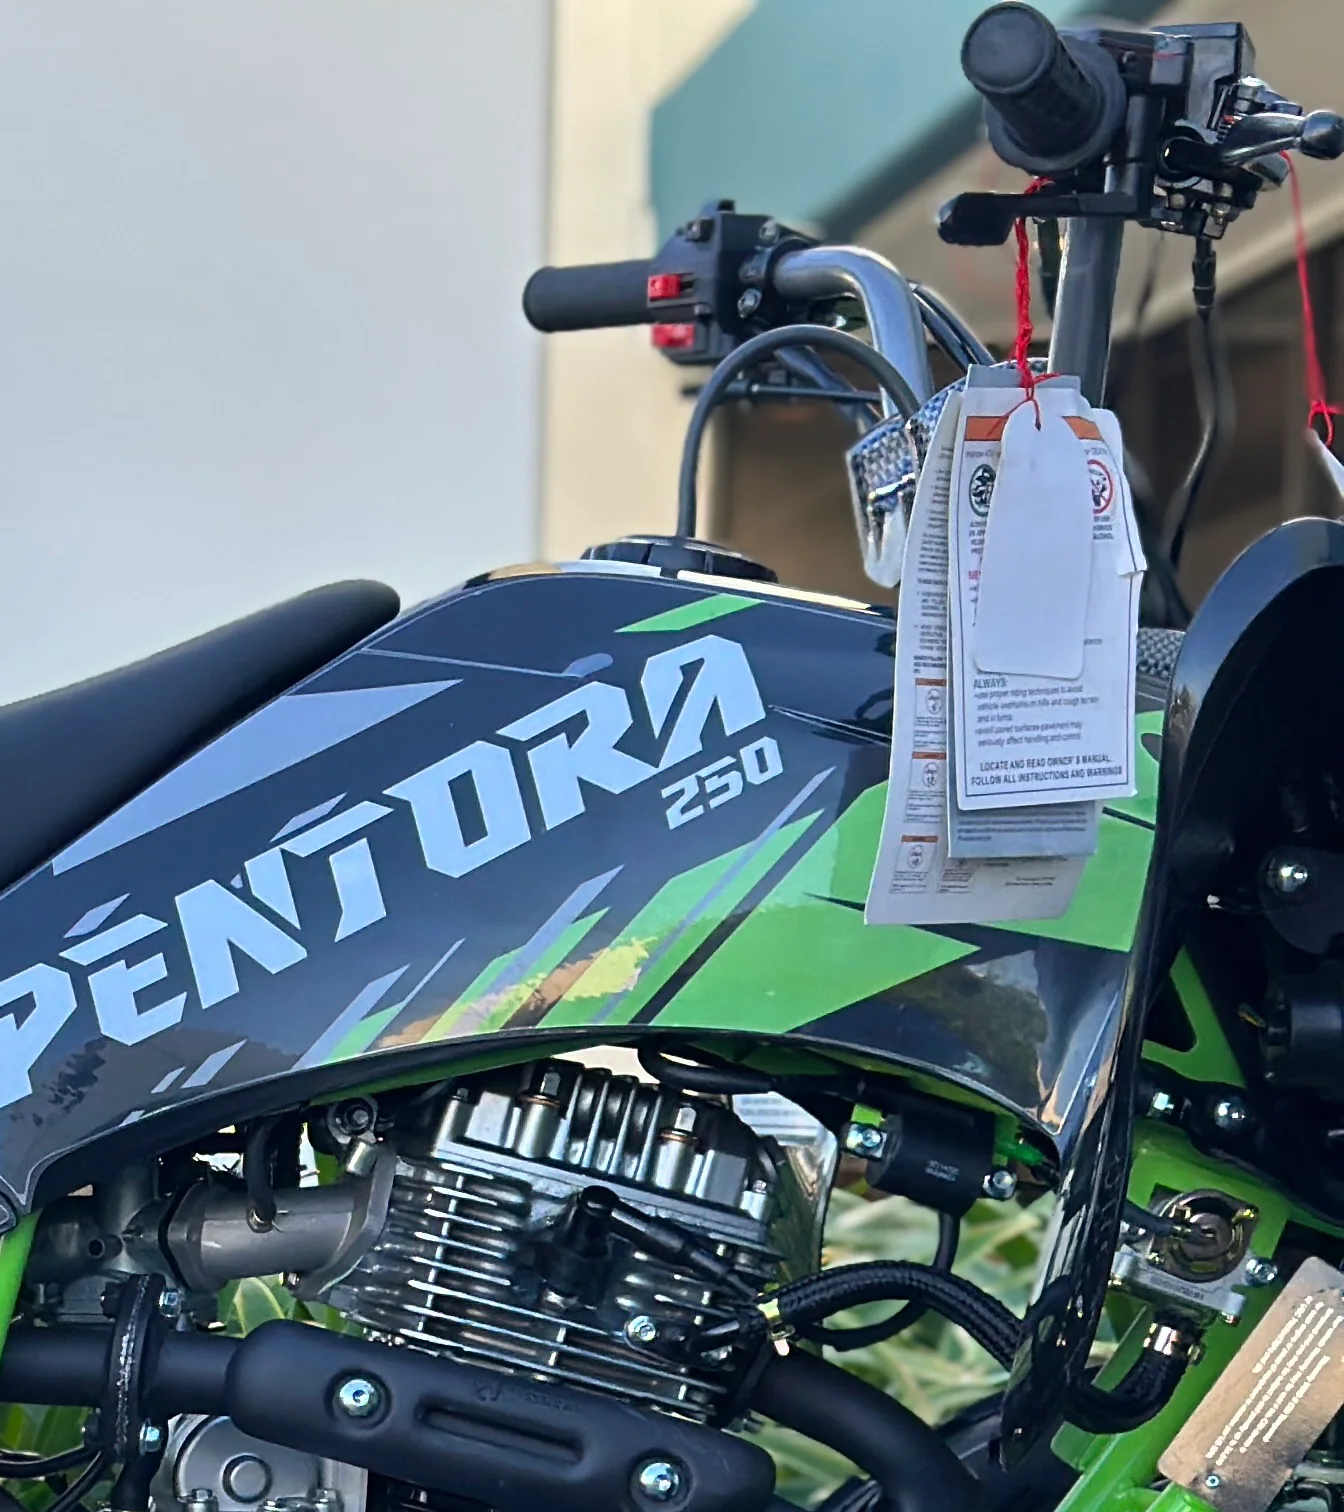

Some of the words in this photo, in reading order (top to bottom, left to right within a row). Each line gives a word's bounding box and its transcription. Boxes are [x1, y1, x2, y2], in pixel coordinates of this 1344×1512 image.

[980, 760, 1009, 772] LOCATE
[1026, 758, 1046, 769] READ
[660, 736, 784, 830] 250
[971, 776, 1002, 786] FOLLOW
[1003, 774, 1016, 784] ALL
[1018, 771, 1070, 783] INSTRUCTIONS
